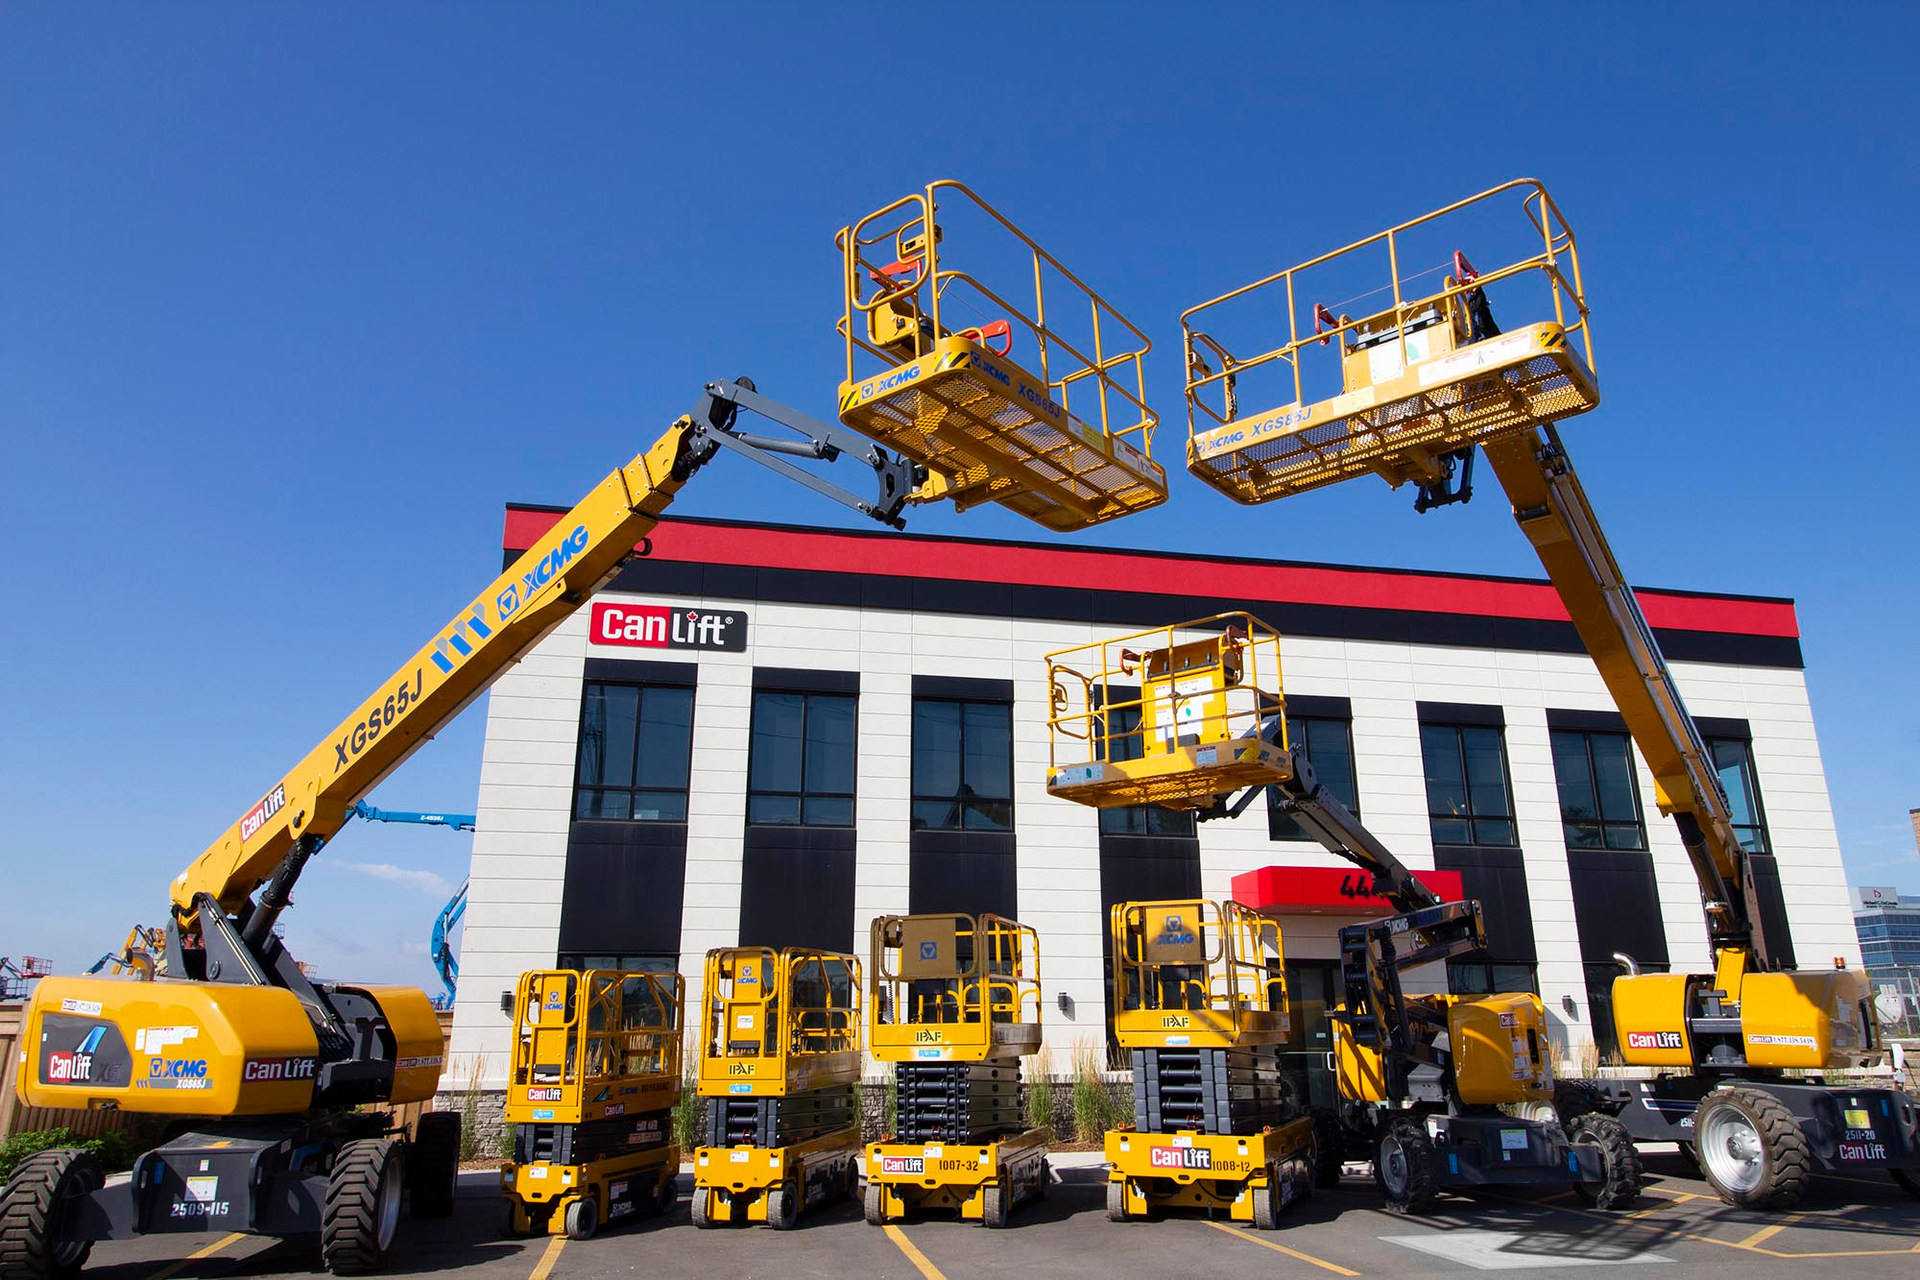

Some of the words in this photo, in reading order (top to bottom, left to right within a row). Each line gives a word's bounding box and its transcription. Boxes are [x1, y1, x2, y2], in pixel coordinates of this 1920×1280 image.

[877, 366, 921, 394] XCMG
[983, 360, 1011, 387] XCMG
[1208, 431, 1244, 450] XCMG
[523, 525, 589, 602] XCMG
[334, 668, 422, 773] XGS65J
[241, 786, 285, 840] CanLift
[1341, 875, 1384, 899] 44
[1157, 933, 1194, 945] XCMG
[1162, 1014, 1189, 1028] IPAF
[916, 1029, 942, 1042] IPAF
[1628, 1032, 1682, 1048] CanLift
[50, 1053, 92, 1079] CanLift
[164, 1060, 207, 1078] XCMG
[245, 1057, 315, 1080] CanLift
[729, 1061, 755, 1075] IPAF
[528, 1088, 562, 1101] CanLift
[1845, 1130, 1876, 1140] 2511-20
[1152, 1147, 1211, 1168] CanLift
[1212, 1161, 1250, 1172] 1008-12
[1839, 1143, 1887, 1159] CanLift
[884, 1158, 923, 1172] CanLift
[939, 1160, 979, 1171] 1007-32
